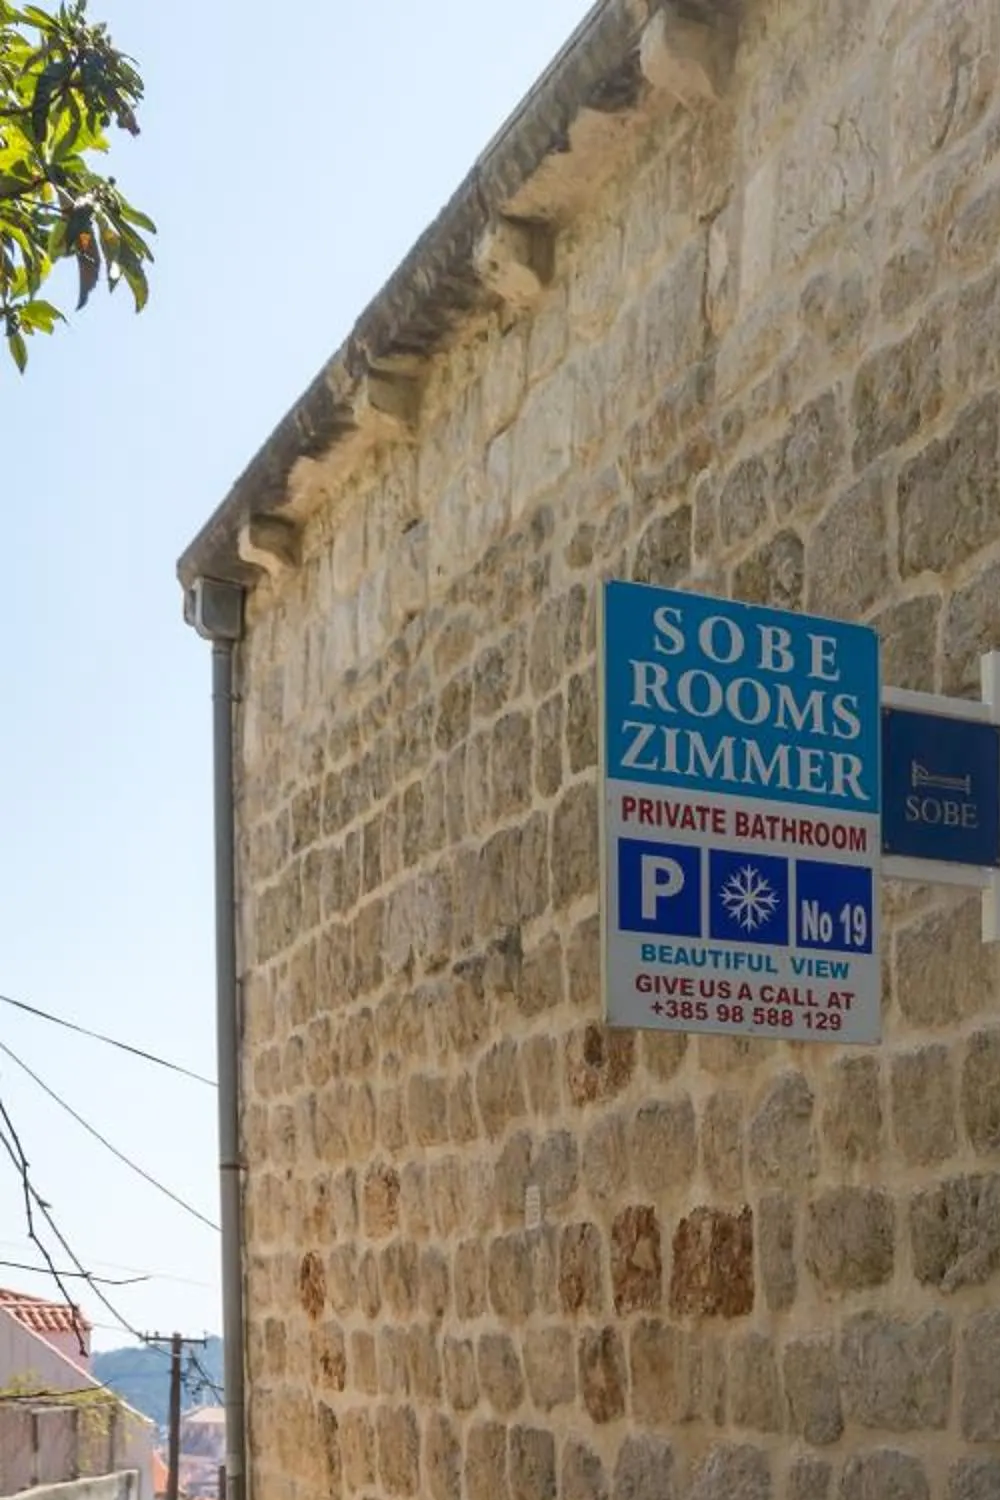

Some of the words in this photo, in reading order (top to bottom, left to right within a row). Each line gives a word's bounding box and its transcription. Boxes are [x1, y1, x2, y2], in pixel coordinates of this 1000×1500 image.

[653, 606, 840, 681] SOBE
[629, 659, 861, 741] ROOMS
[620, 722, 870, 800] ZIMMER
[621, 795, 726, 835] PRIVATE
[735, 812, 867, 852] BATHROOM
[905, 796, 979, 829] SOBE
[641, 854, 685, 920] P
[802, 900, 832, 943] No
[840, 904, 867, 947] 19
[641, 943, 778, 974] BEAUTIFUL
[790, 957, 850, 980] VIEW
[635, 974, 695, 997] GIVE
[699, 979, 731, 999] US
[736, 984, 753, 1001] A
[759, 986, 818, 1008] CALL
[827, 992, 855, 1010] AT
[651, 1001, 708, 1022] +385
[716, 1006, 743, 1024] 98
[752, 1008, 793, 1027] 588
[802, 1011, 841, 1031] 129
